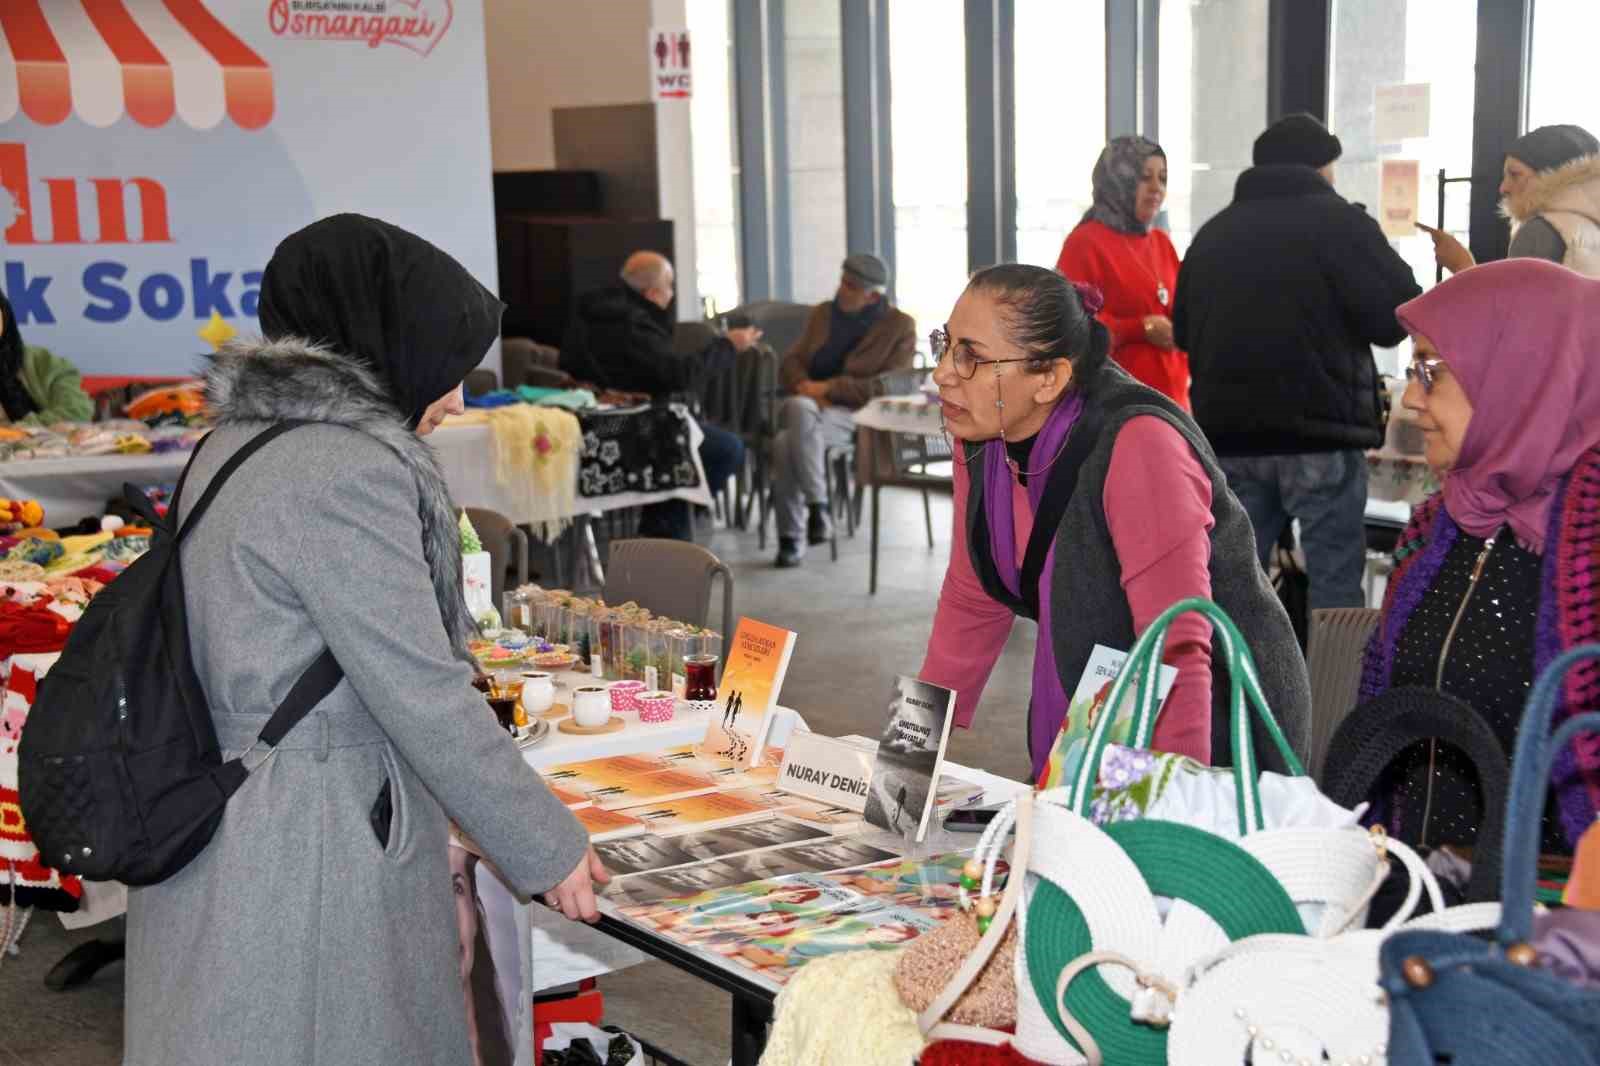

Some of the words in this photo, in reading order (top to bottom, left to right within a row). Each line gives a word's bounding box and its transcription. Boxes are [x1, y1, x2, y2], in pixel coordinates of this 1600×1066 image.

[658, 75, 689, 87] WC
[786, 763, 830, 786] NURAY
[830, 774, 868, 797] DENİZ
